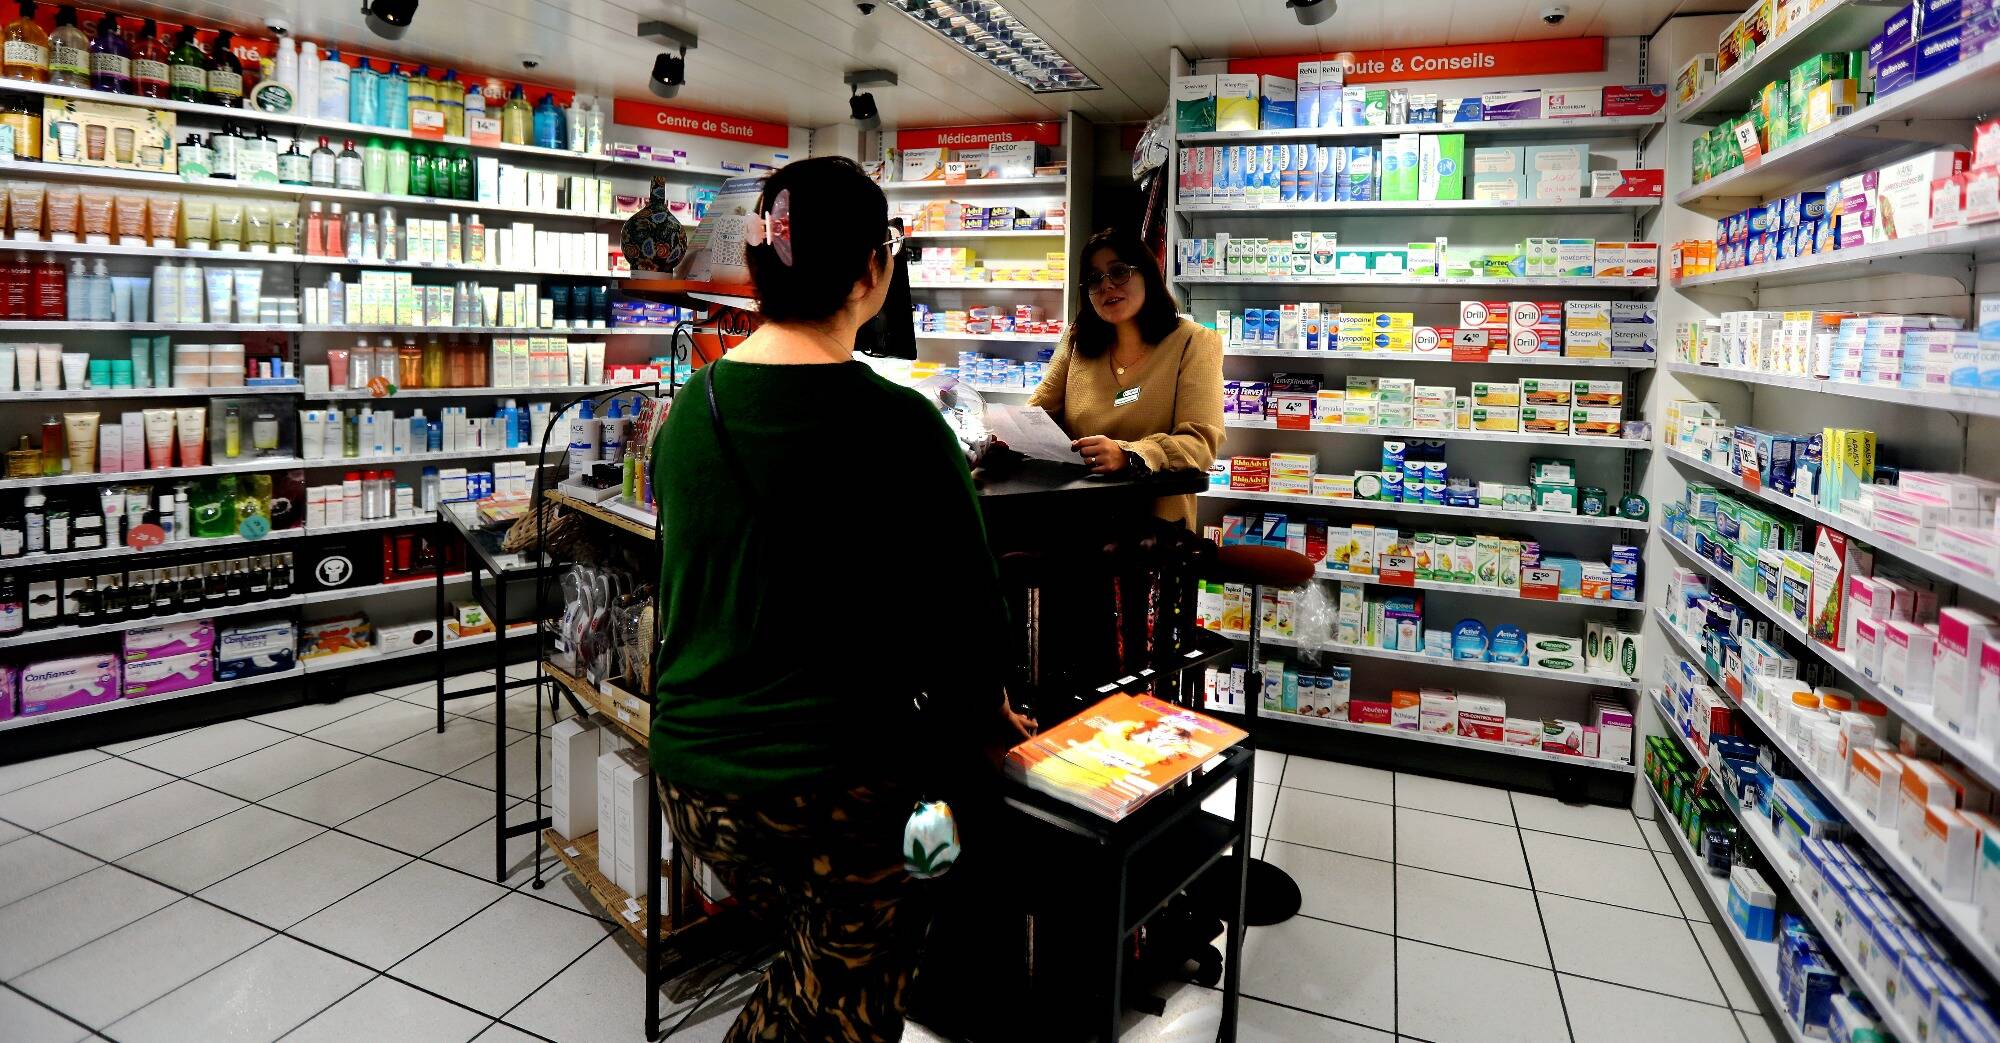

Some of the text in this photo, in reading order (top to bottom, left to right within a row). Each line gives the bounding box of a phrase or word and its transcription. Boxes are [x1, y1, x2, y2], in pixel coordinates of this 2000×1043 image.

[1343, 52, 1496, 75] oute & Conseils
[1299, 67, 1317, 75] ReNu
[1322, 66, 1340, 74] ReNu
[656, 111, 754, 137] Centre de Santé
[937, 131, 1013, 145] Médicaments
[1485, 259, 1508, 268] Zyrtec
[1569, 302, 1601, 311] Strepsils
[1615, 302, 1648, 311] Strepsils
[1466, 310, 1484, 319] Drill
[1518, 311, 1536, 321] Drill
[1300, 308, 1308, 338] Maxilase
[1569, 330, 1601, 338] Strepsils
[1614, 331, 1648, 339] Strepsils
[1417, 336, 1435, 344] Drill
[1517, 338, 1536, 347] Drill
[1240, 387, 1264, 396] FERVEX
[1233, 459, 1268, 467] RhinAdvil
[1232, 475, 1267, 483] RhinAdvil
[1531, 572, 1550, 582] 5.50
[1583, 574, 1610, 582] Exomuc
[127, 626, 164, 636] Confiance
[1458, 626, 1481, 636] Activir
[1496, 629, 1518, 639] Activir
[223, 633, 267, 645] Confiance
[127, 659, 163, 670] Confiance
[25, 667, 76, 683] Confiance
